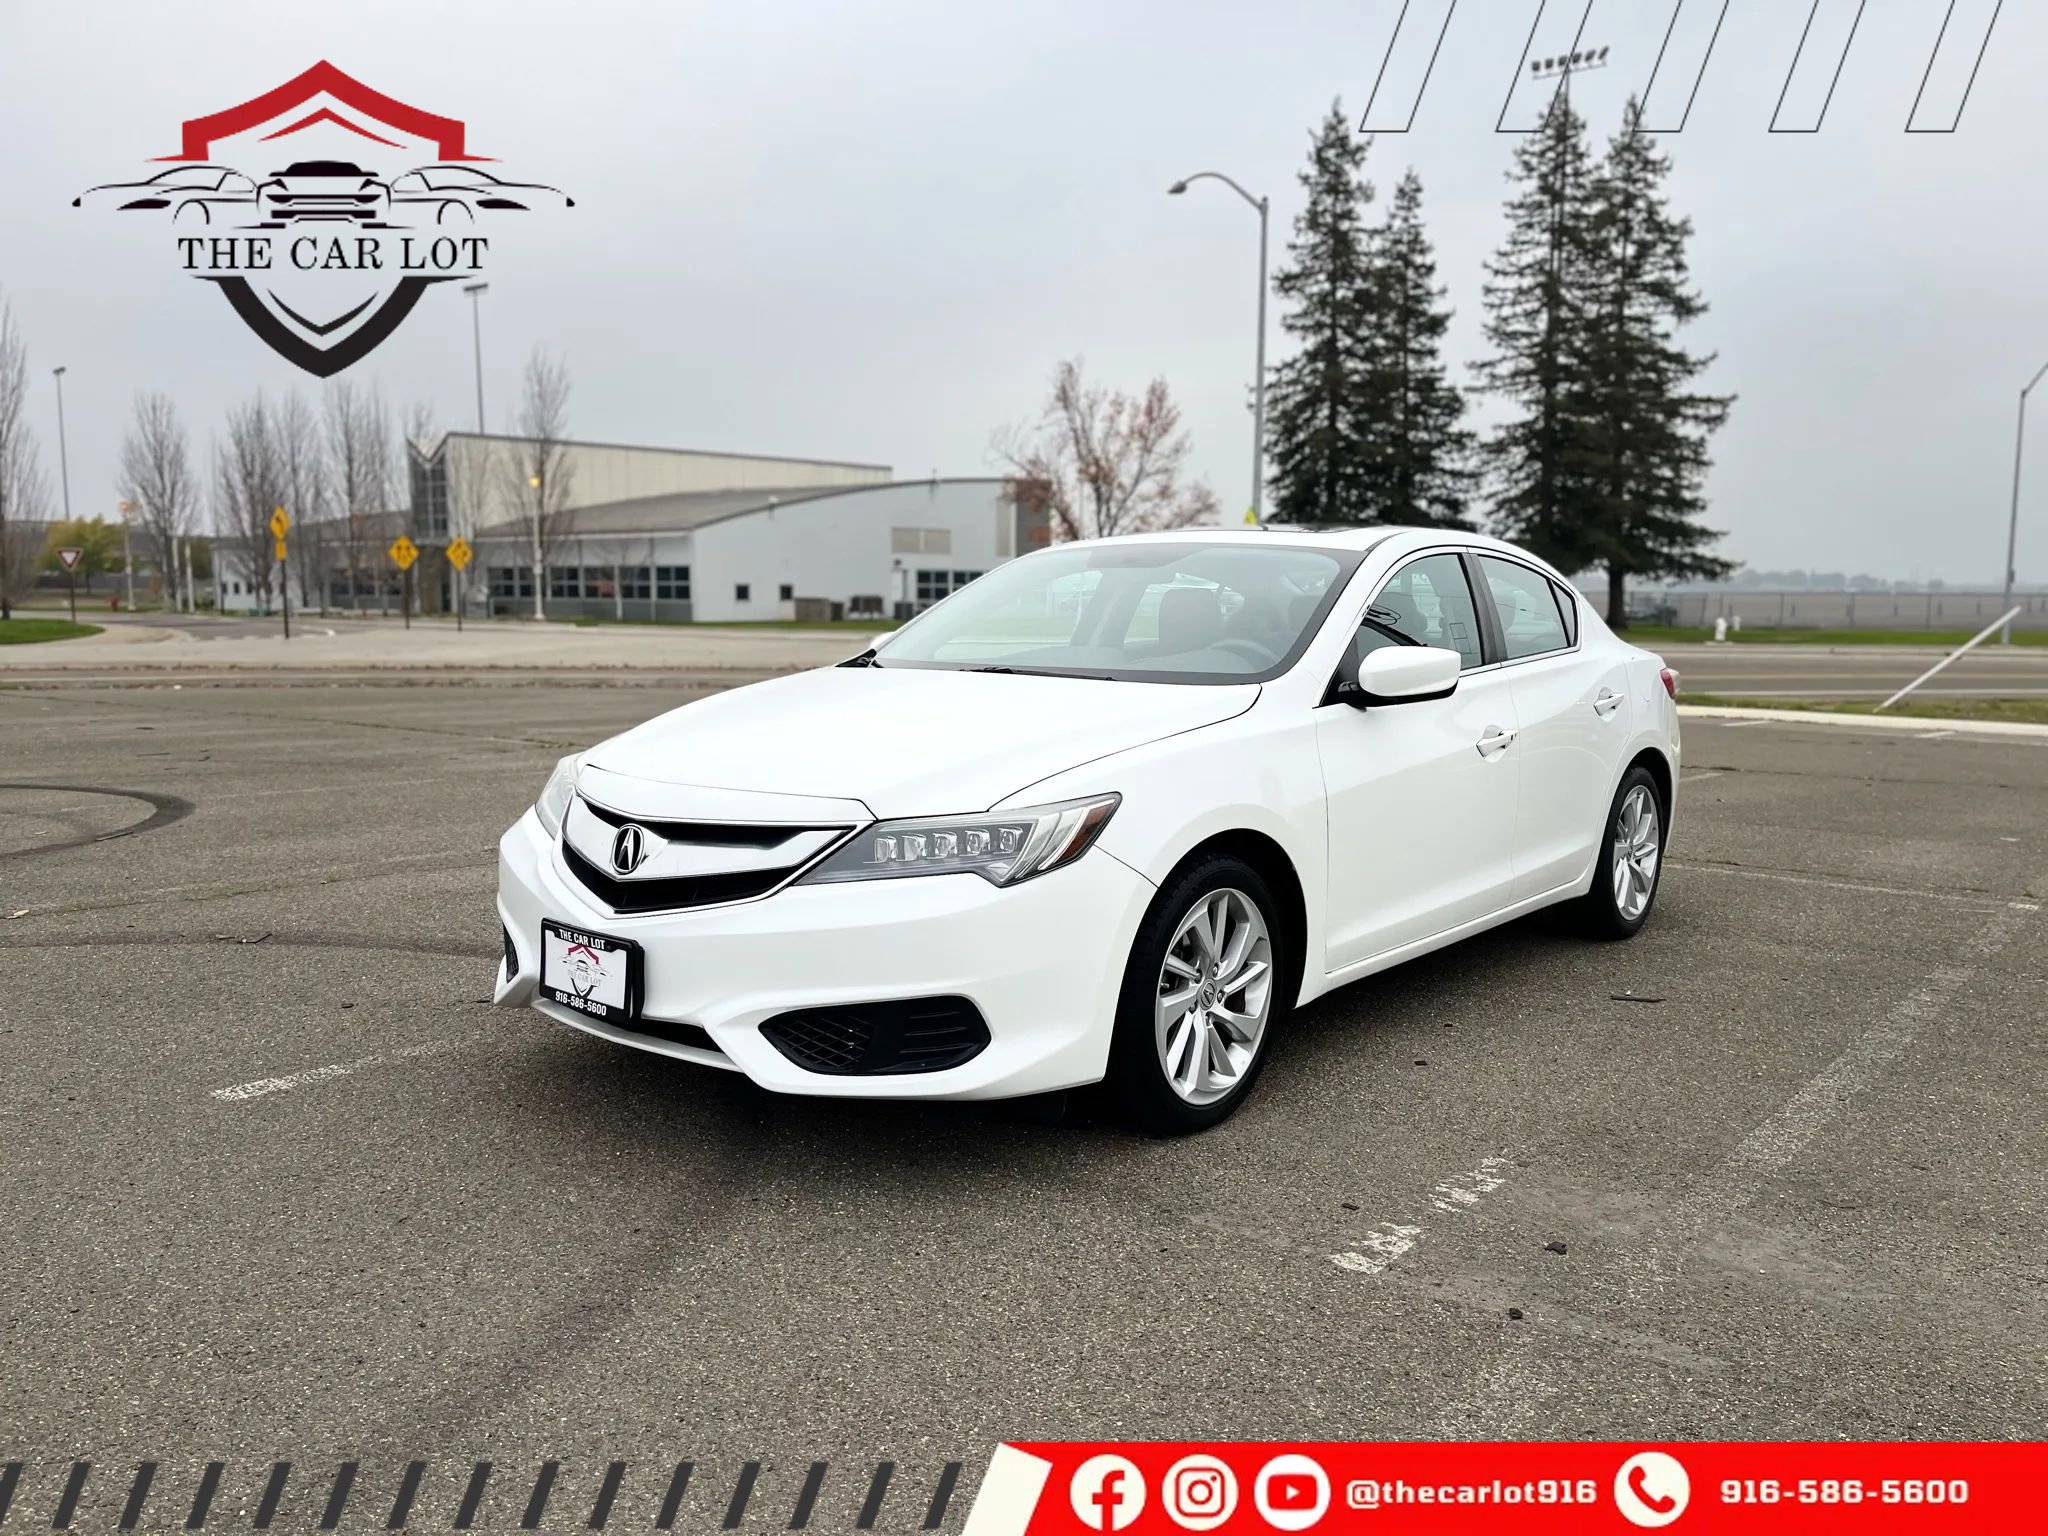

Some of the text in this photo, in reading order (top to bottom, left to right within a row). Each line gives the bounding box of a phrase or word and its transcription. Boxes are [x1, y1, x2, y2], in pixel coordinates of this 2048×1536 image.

[559, 928, 605, 950] THE CAR LOT
[555, 990, 607, 1016] 916-586-5600
